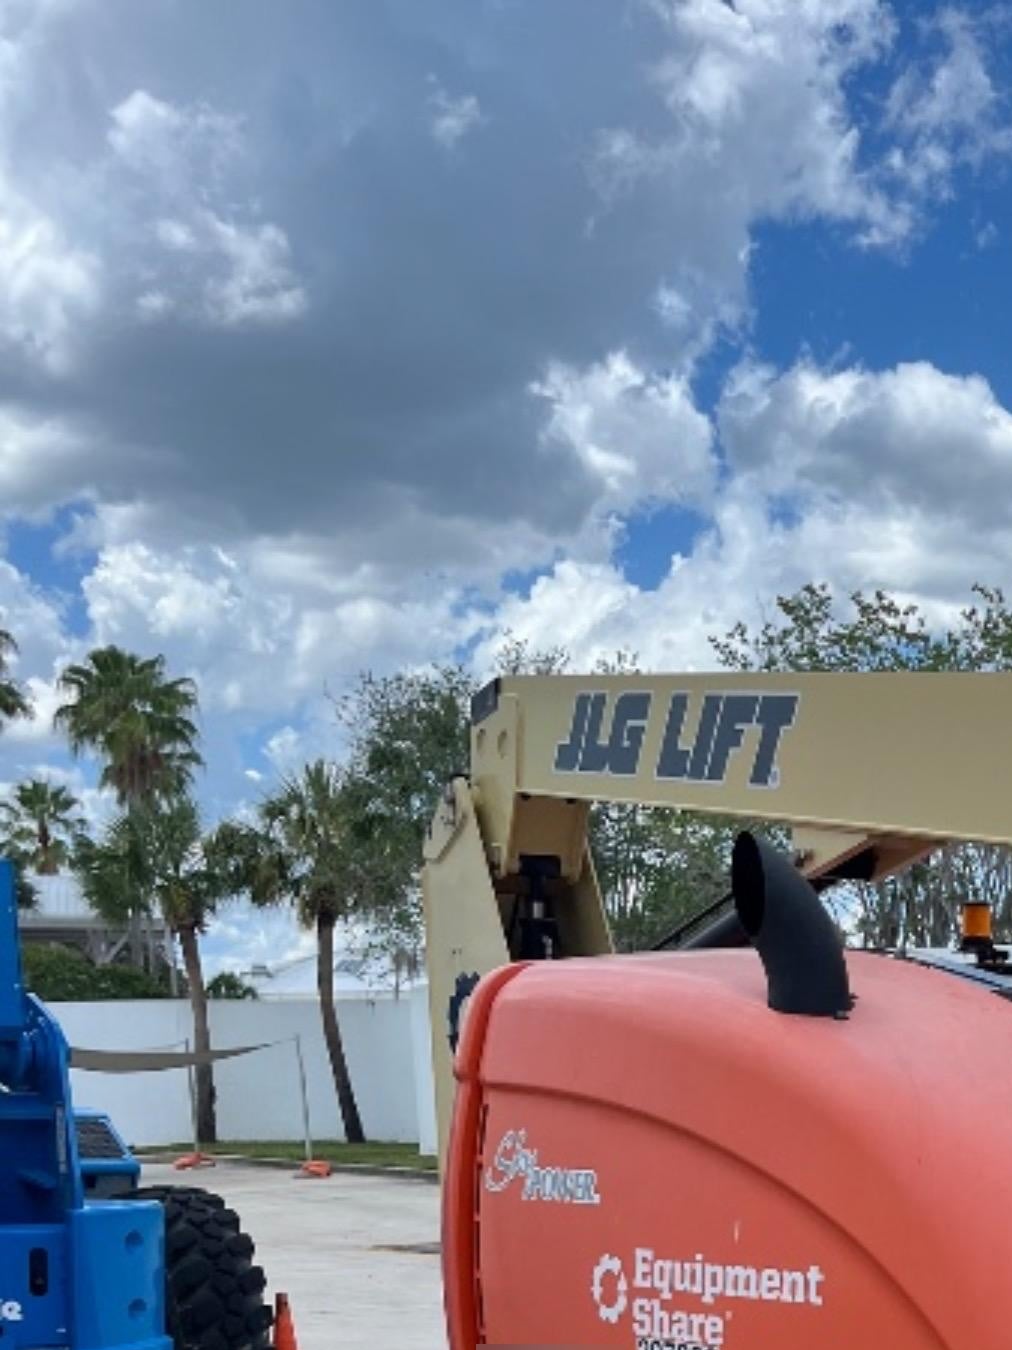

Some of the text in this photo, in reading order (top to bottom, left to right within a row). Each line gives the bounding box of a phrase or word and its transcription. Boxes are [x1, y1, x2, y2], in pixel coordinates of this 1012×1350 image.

[554, 691, 799, 787] JLG LIFT
[632, 1248, 825, 1305] Equipment
[632, 1298, 725, 1345] Share
